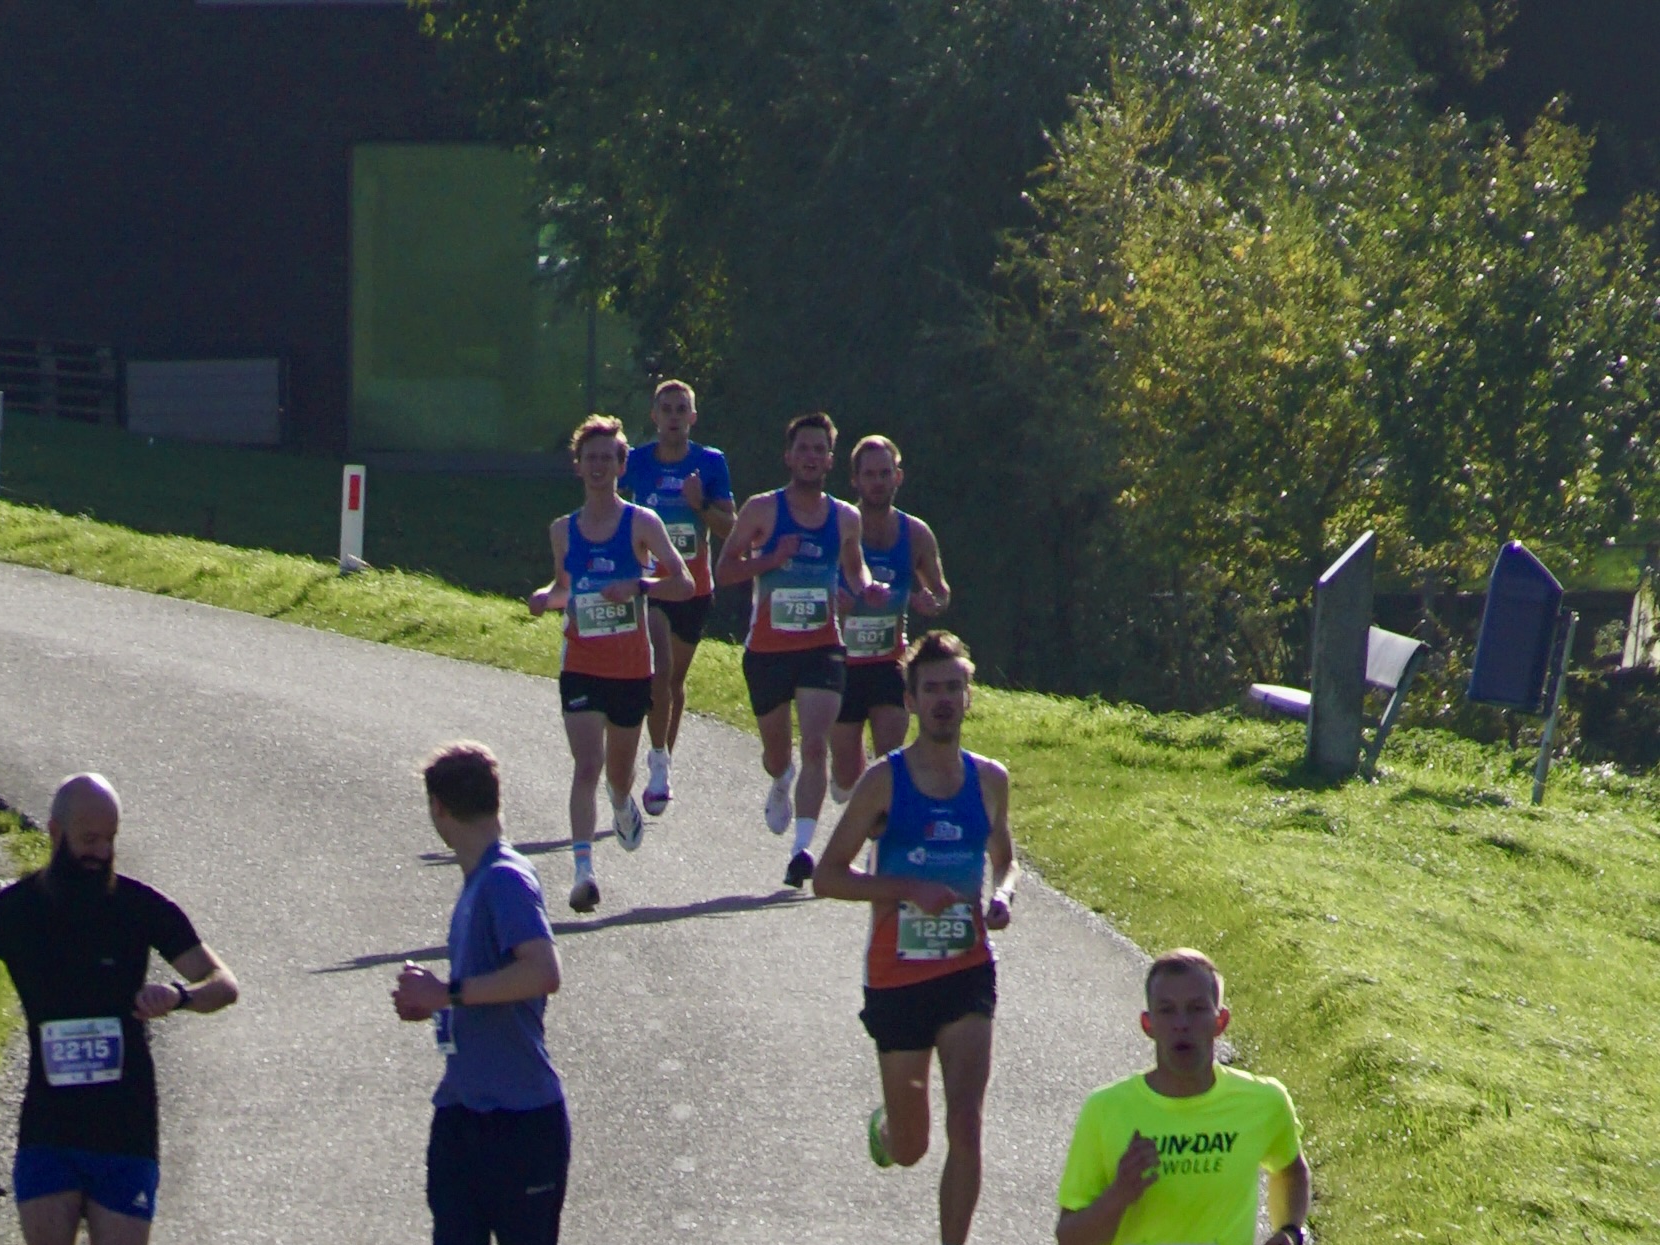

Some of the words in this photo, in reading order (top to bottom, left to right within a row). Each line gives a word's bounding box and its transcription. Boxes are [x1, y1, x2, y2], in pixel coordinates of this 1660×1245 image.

[586, 604, 627, 620] 1268
[785, 602, 816, 615] 789
[857, 630, 885, 643] 601
[912, 920, 967, 938] 1229
[51, 1040, 110, 1062] 2215
[1153, 1132, 1238, 1155] UNDAY
[1161, 1157, 1223, 1175] WOLLE
